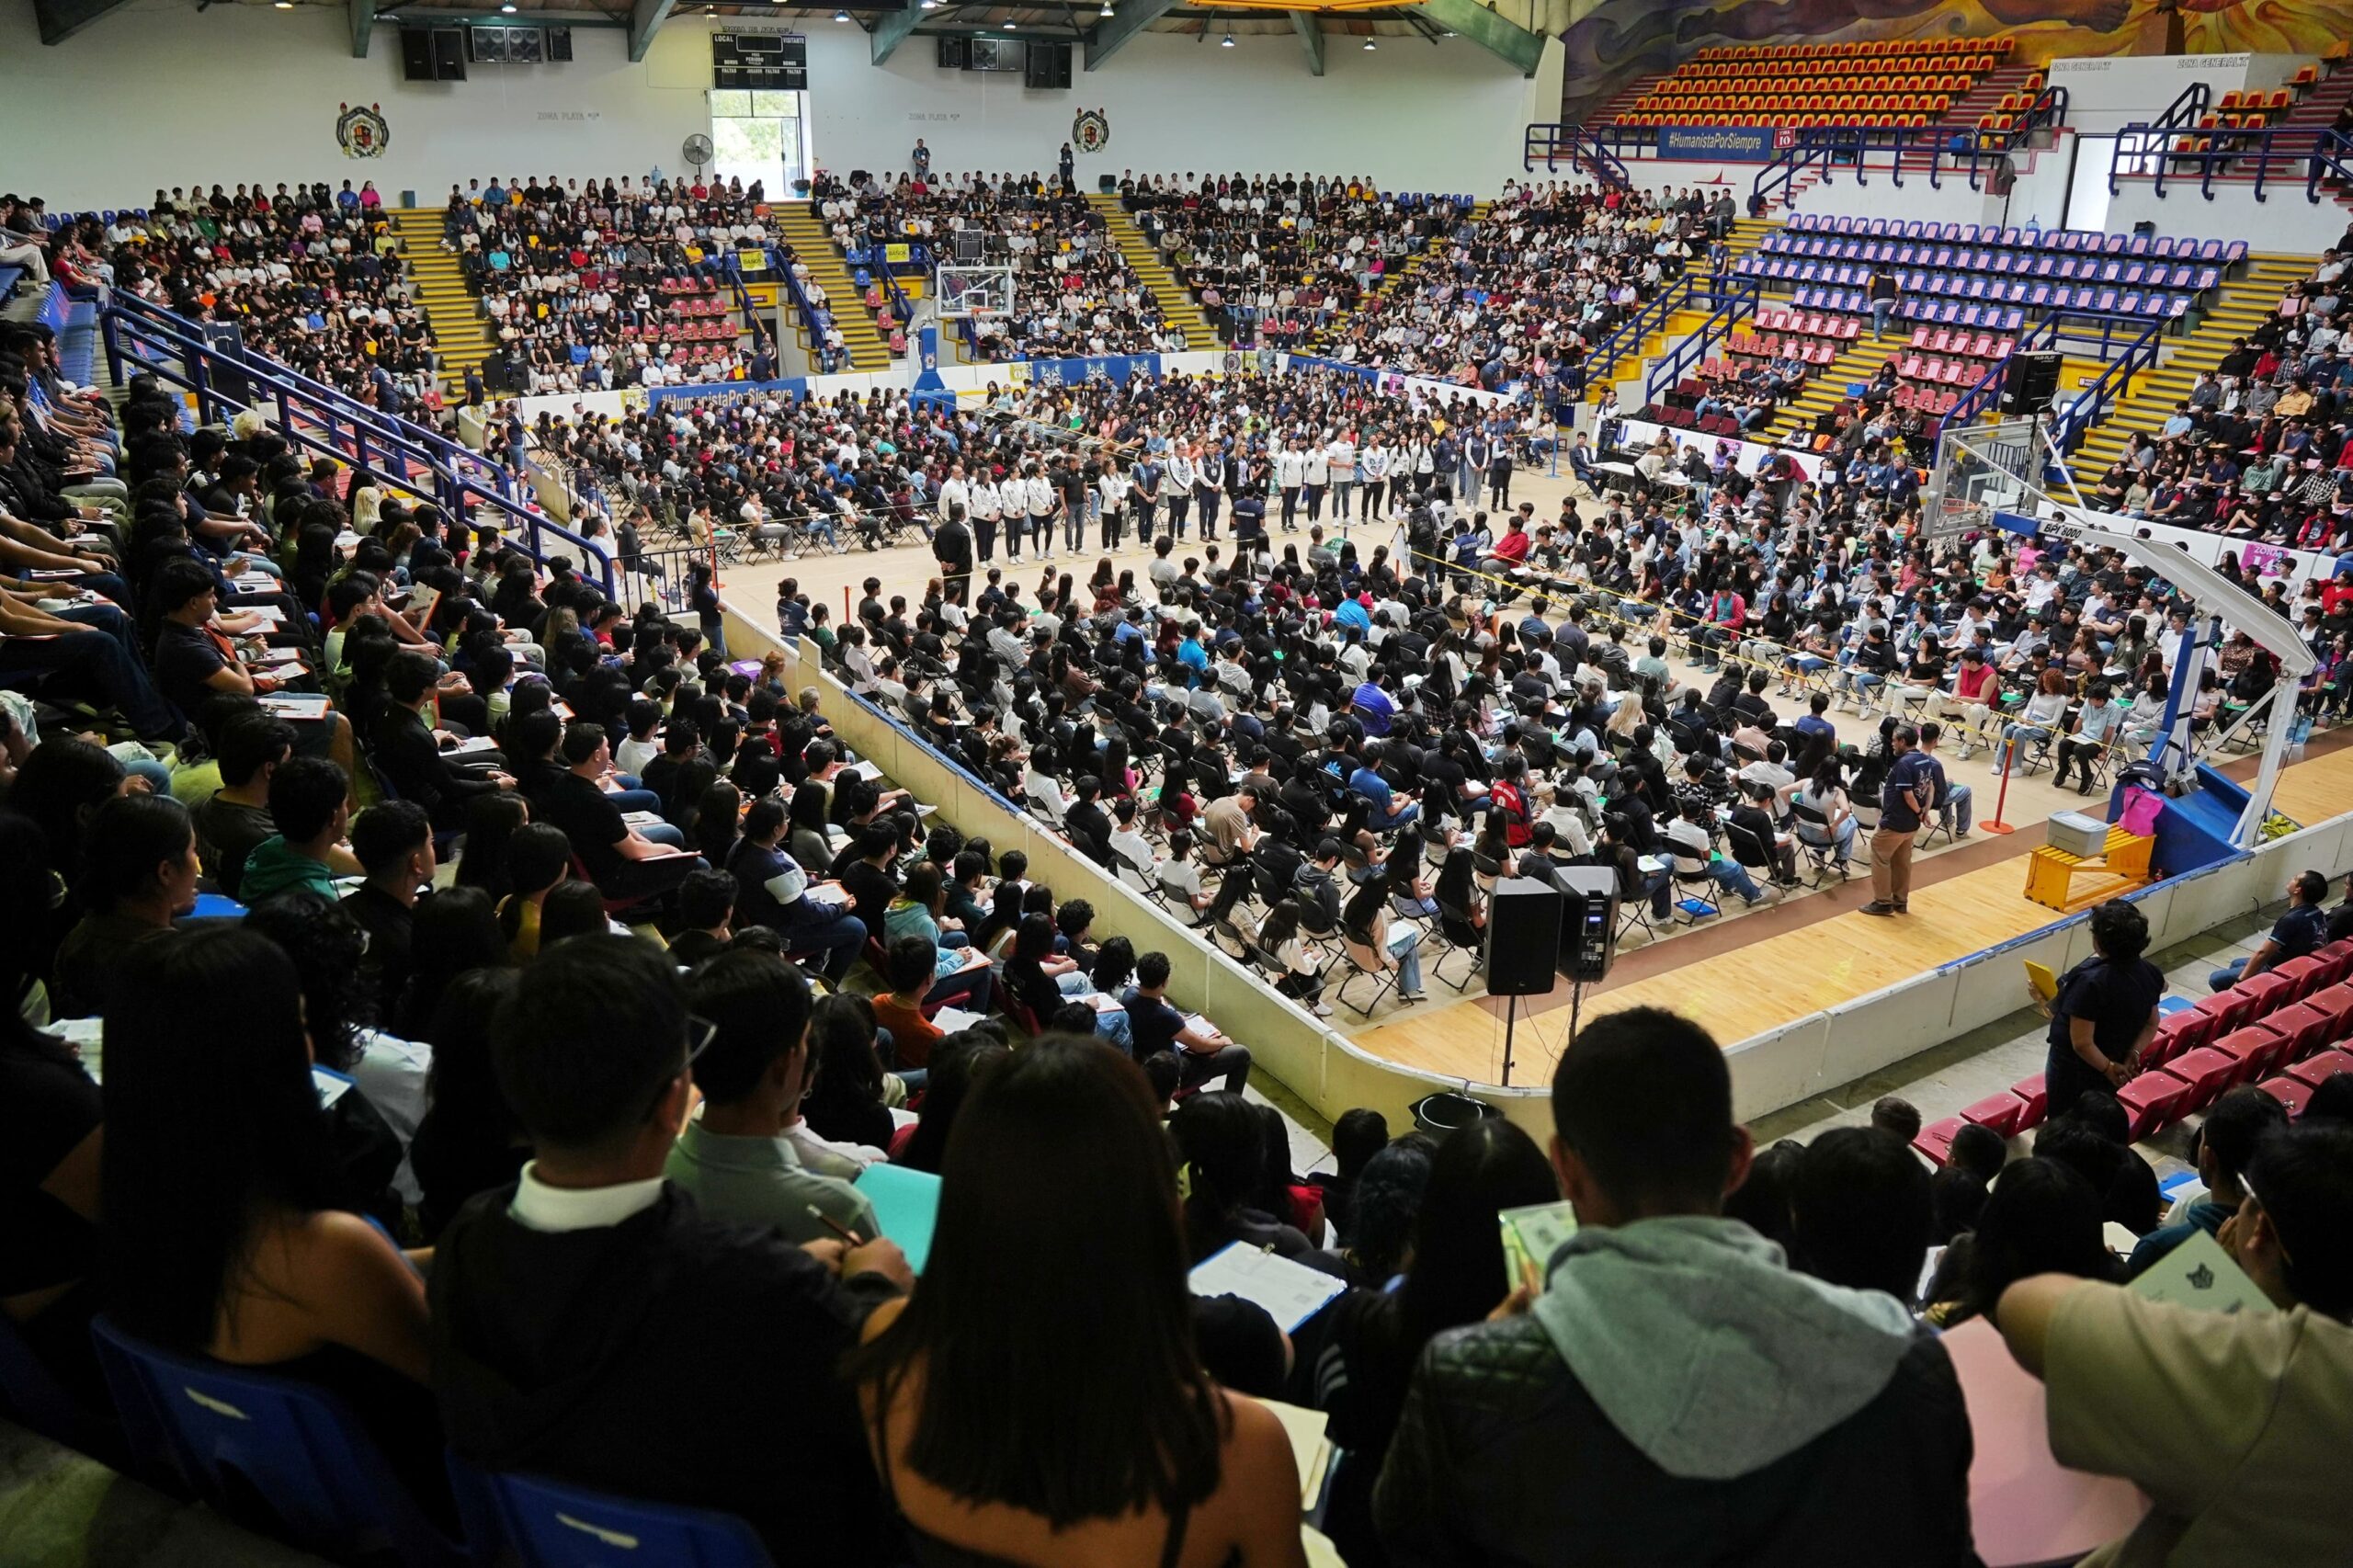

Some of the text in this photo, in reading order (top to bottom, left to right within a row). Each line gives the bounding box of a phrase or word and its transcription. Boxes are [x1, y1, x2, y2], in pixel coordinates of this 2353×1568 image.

[2051, 62, 2070, 72] ZONA
[2177, 59, 2199, 68] ZONA
[537, 111, 558, 120] ZONA
[562, 111, 585, 120] PLATA
[1668, 131, 1761, 153] #HumanistaPorSiempre
[1779, 136, 1790, 145] 10
[2043, 524, 2082, 539] BPI 8000
[2254, 546, 2278, 557] ZONA
[2254, 556, 2275, 573] 14
